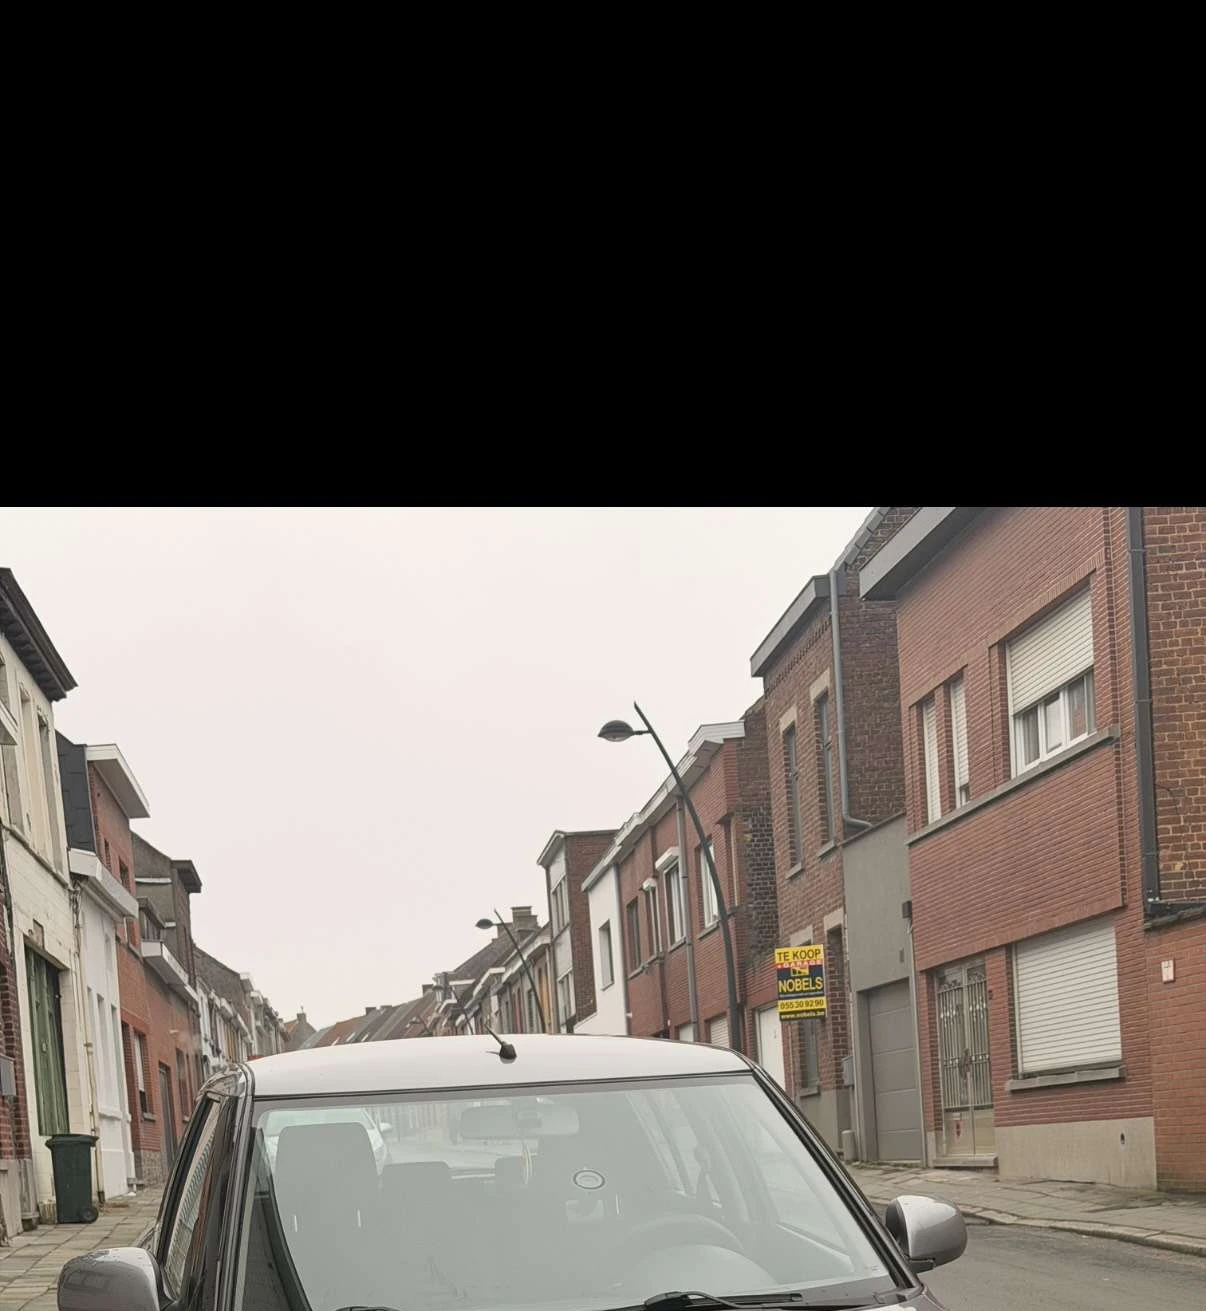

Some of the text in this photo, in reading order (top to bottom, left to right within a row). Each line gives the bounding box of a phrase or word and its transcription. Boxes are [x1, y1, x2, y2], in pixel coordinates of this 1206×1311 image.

[777, 949, 820, 961] TE KOOP
[778, 976, 824, 993] NOBELS
